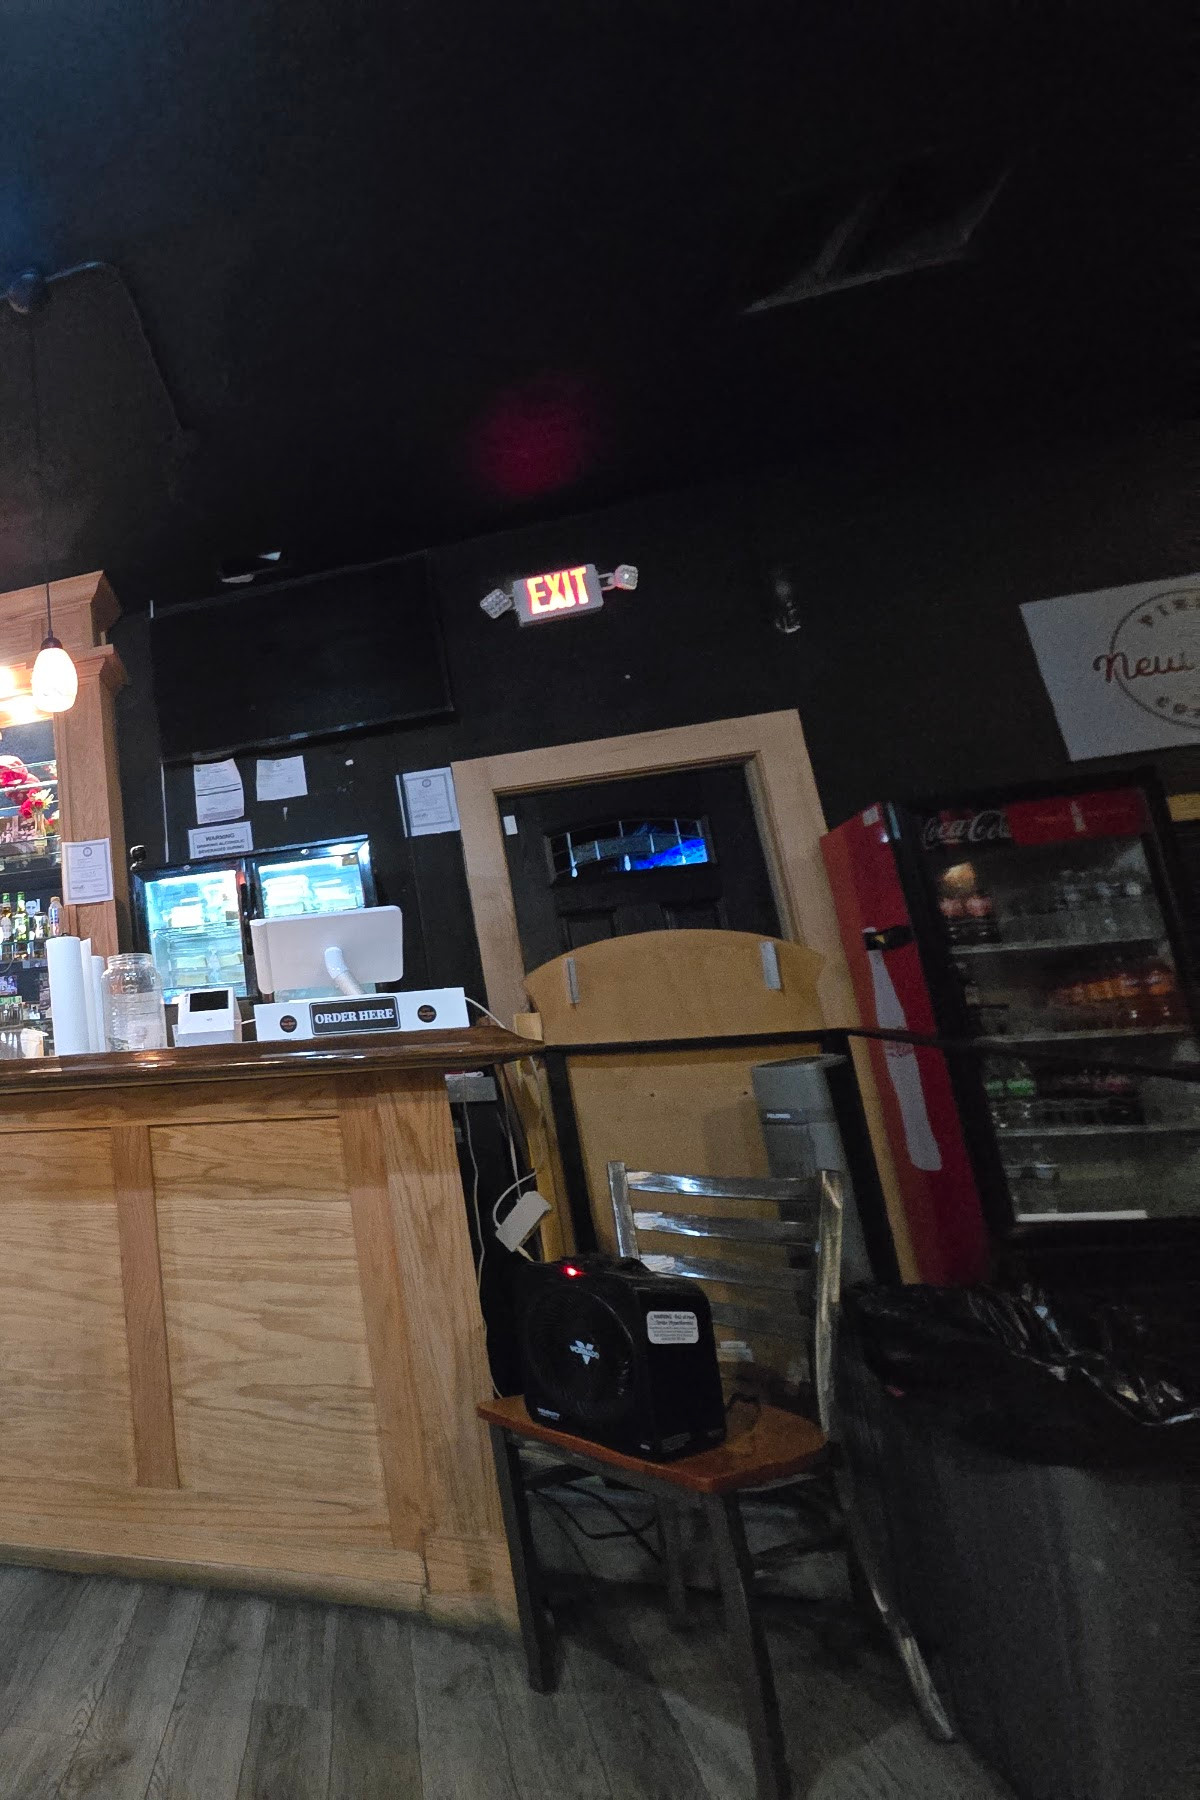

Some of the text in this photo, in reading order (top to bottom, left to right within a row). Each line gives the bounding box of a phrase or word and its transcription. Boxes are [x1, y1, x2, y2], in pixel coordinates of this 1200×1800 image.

[526, 566, 589, 615] EXIT
[314, 1011, 358, 1025] ORDER
[358, 1008, 395, 1021] HERE
